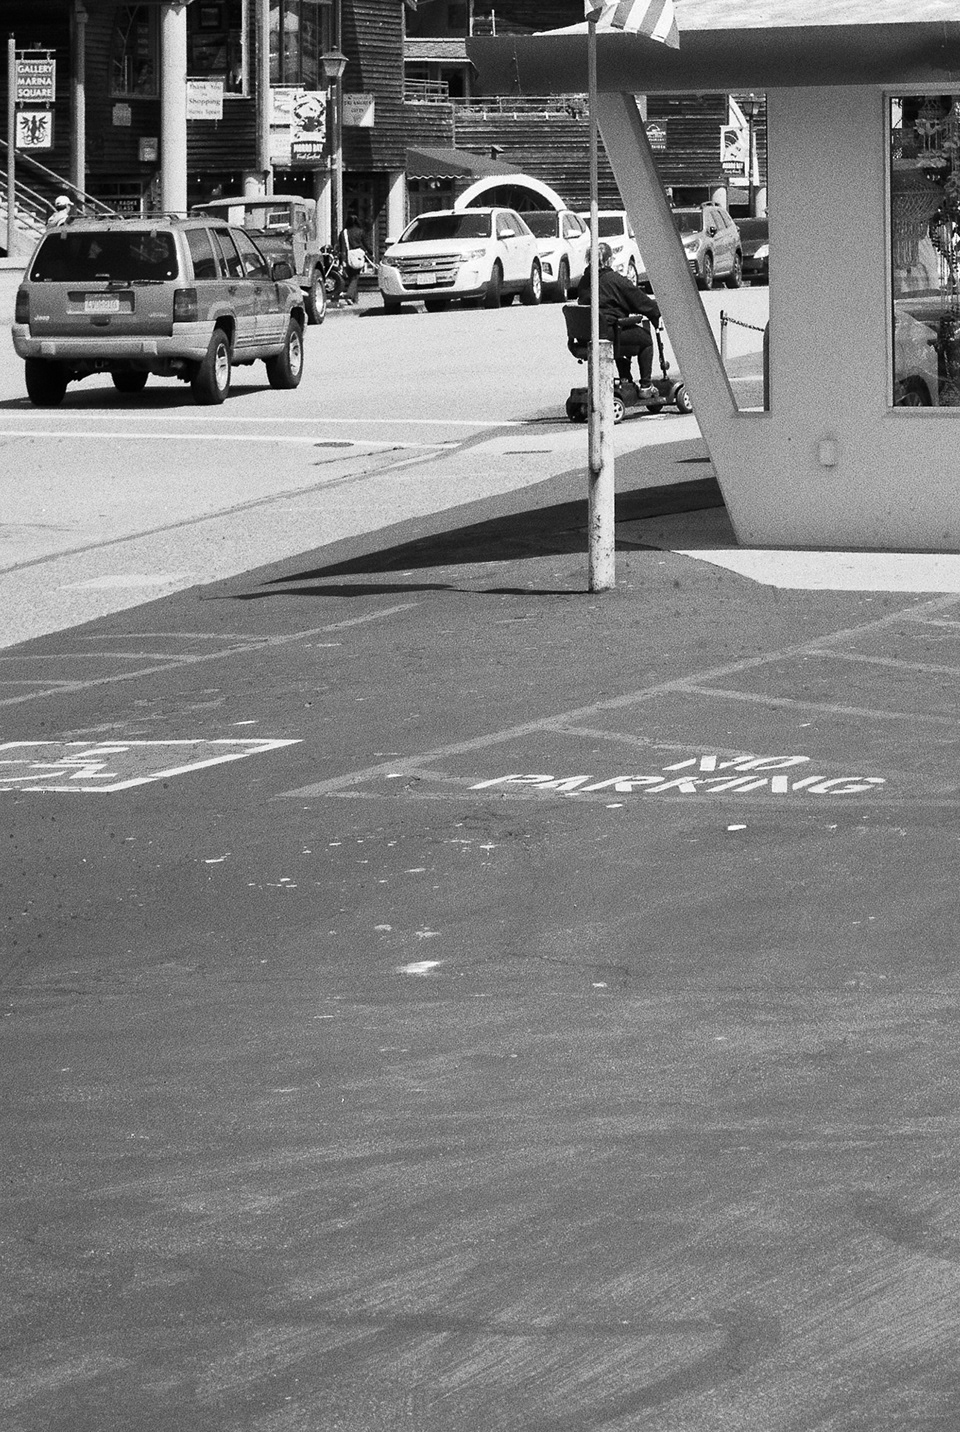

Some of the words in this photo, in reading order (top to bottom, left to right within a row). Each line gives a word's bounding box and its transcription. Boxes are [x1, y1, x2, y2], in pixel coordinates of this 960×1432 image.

[17, 65, 53, 73] GALLERY
[17, 77, 53, 85] MARINA
[18, 89, 53, 97] SQUARE
[662, 755, 811, 772] NO
[466, 773, 887, 795] PARKING
